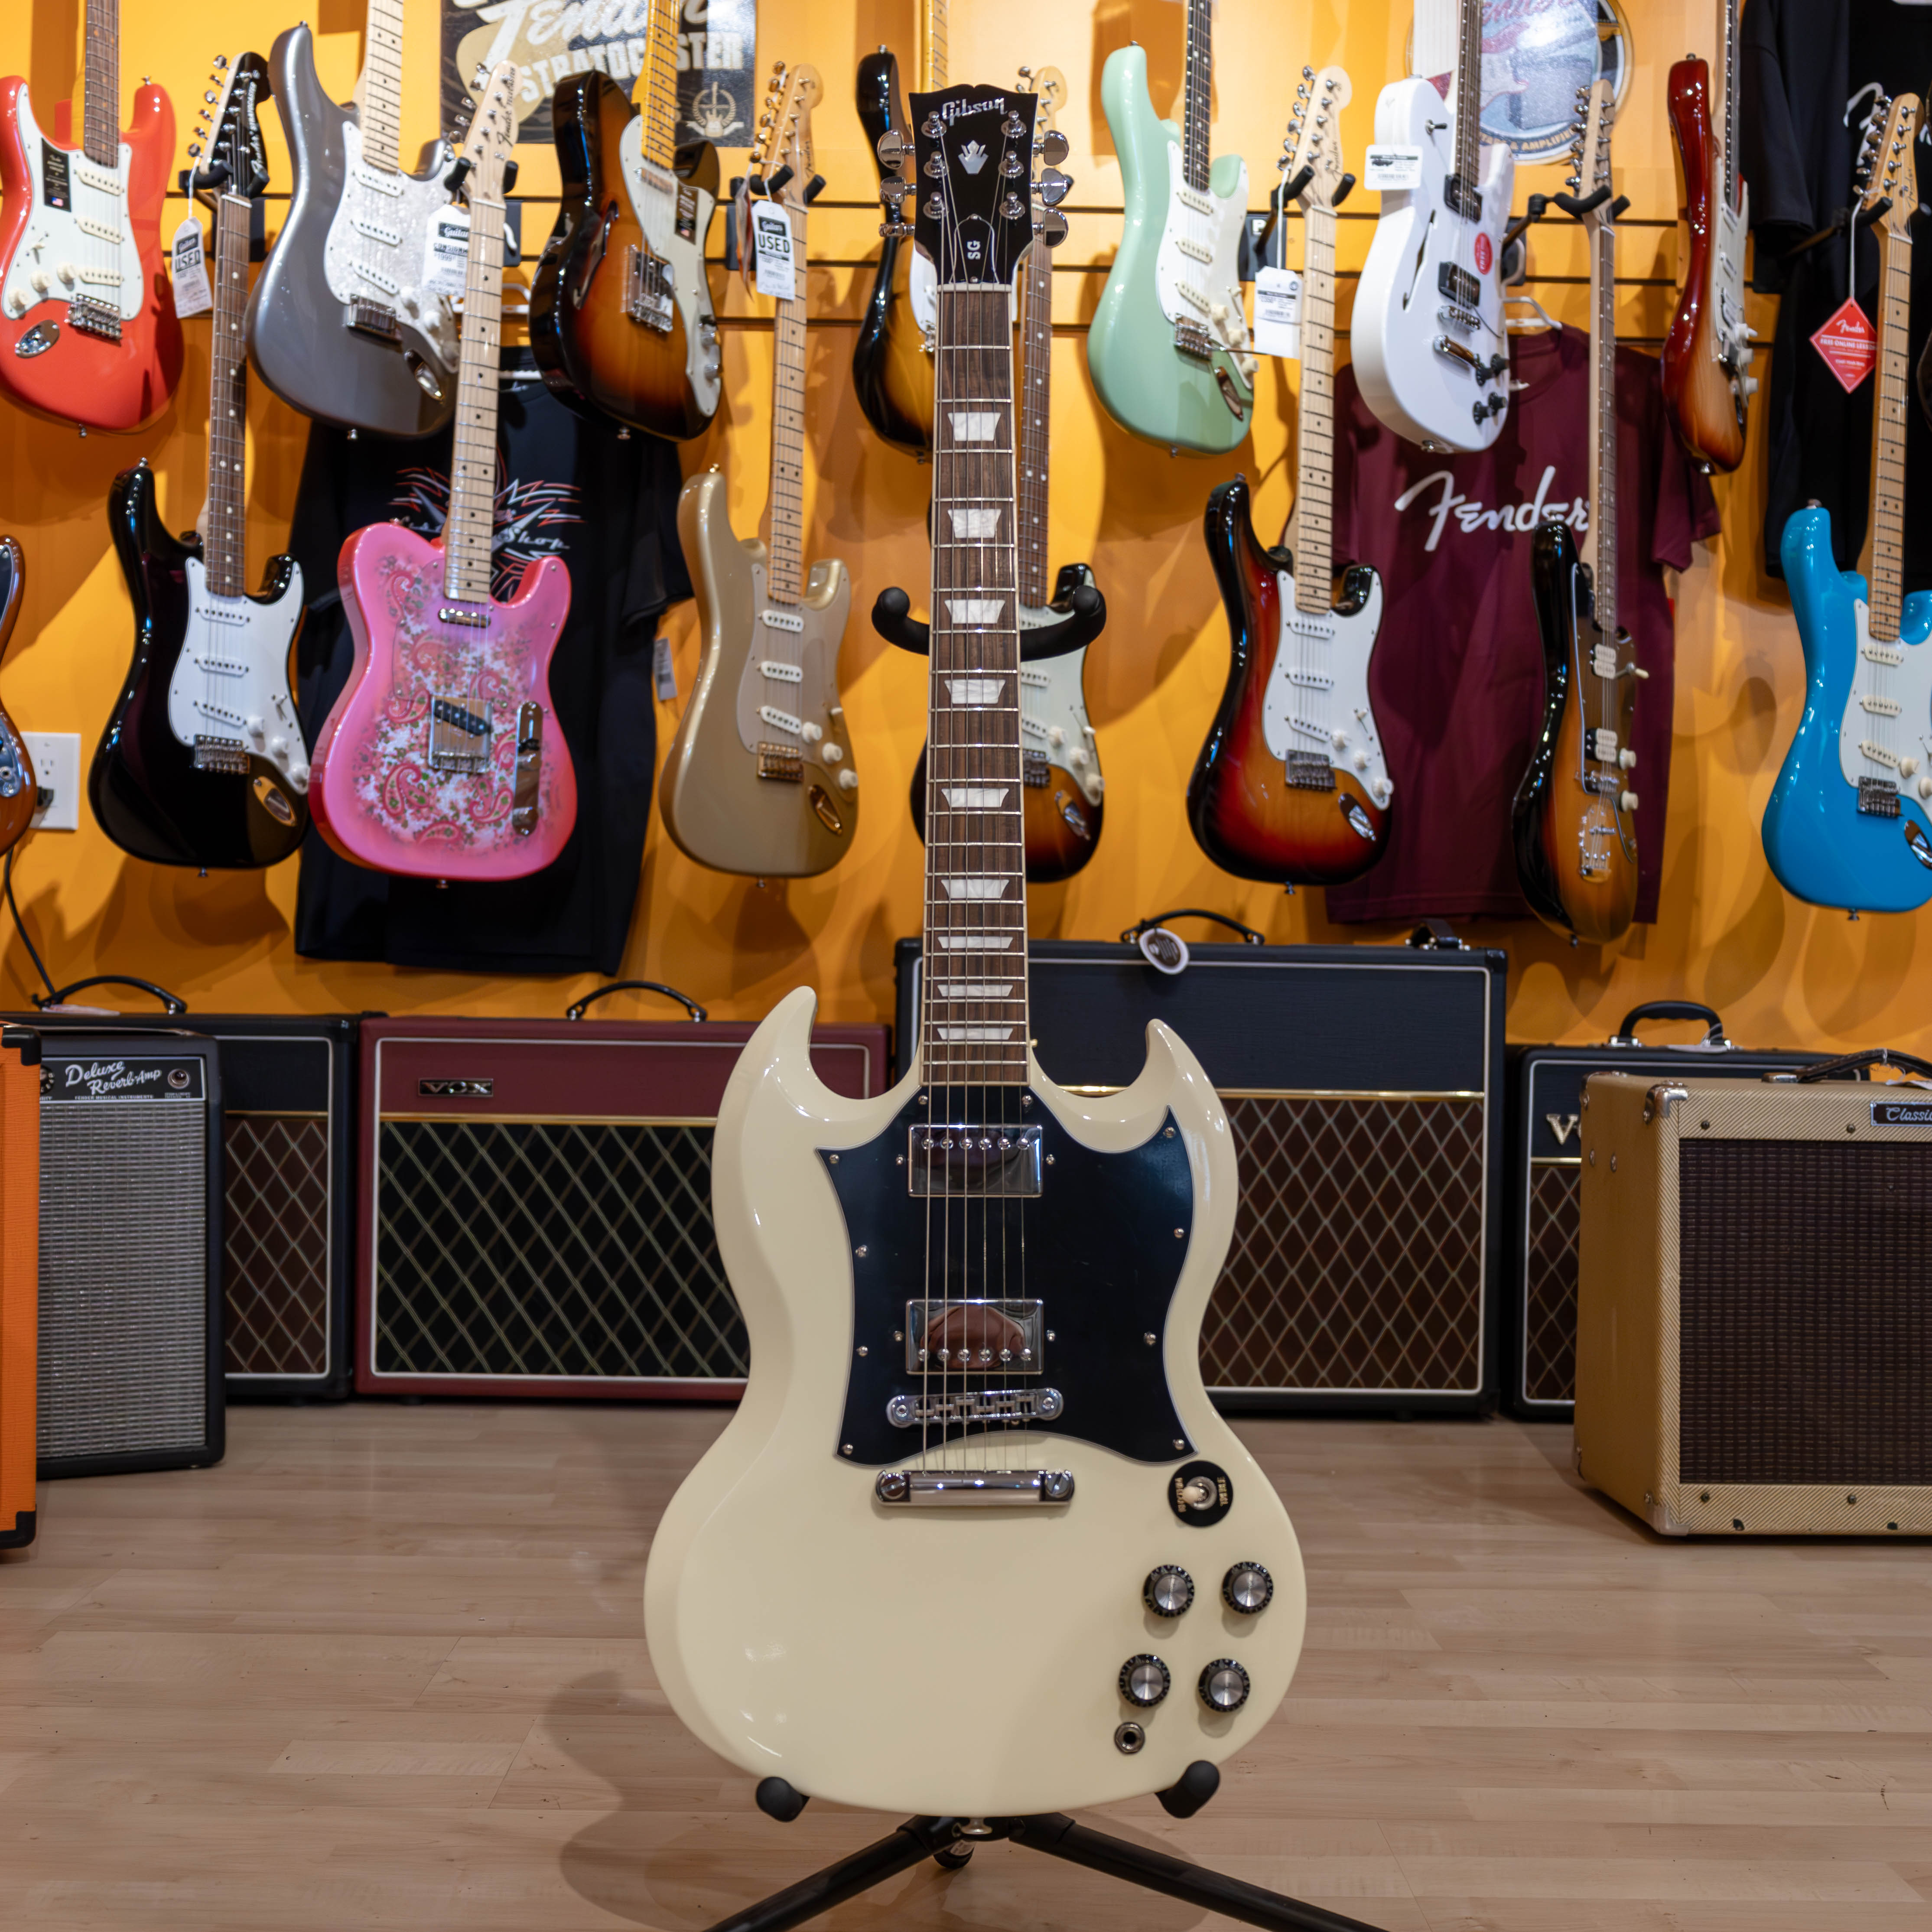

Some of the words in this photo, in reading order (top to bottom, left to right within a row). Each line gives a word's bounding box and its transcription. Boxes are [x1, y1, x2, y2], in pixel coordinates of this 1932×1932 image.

[520, 32, 743, 103] STRATOCSTER
[247, 81, 257, 130] STRATOCASTER
[942, 97, 1008, 126] Gibson
[758, 234, 790, 253] USED
[967, 241, 981, 260] SG
[175, 250, 201, 270] USED
[1836, 319, 1865, 334] Fender
[1394, 465, 1589, 551] Fender
[65, 1061, 125, 1087] Deluxe
[87, 1069, 162, 1095] Reverb-Amp
[422, 1081, 491, 1094] VOX
[1546, 1113, 1581, 1145] V
